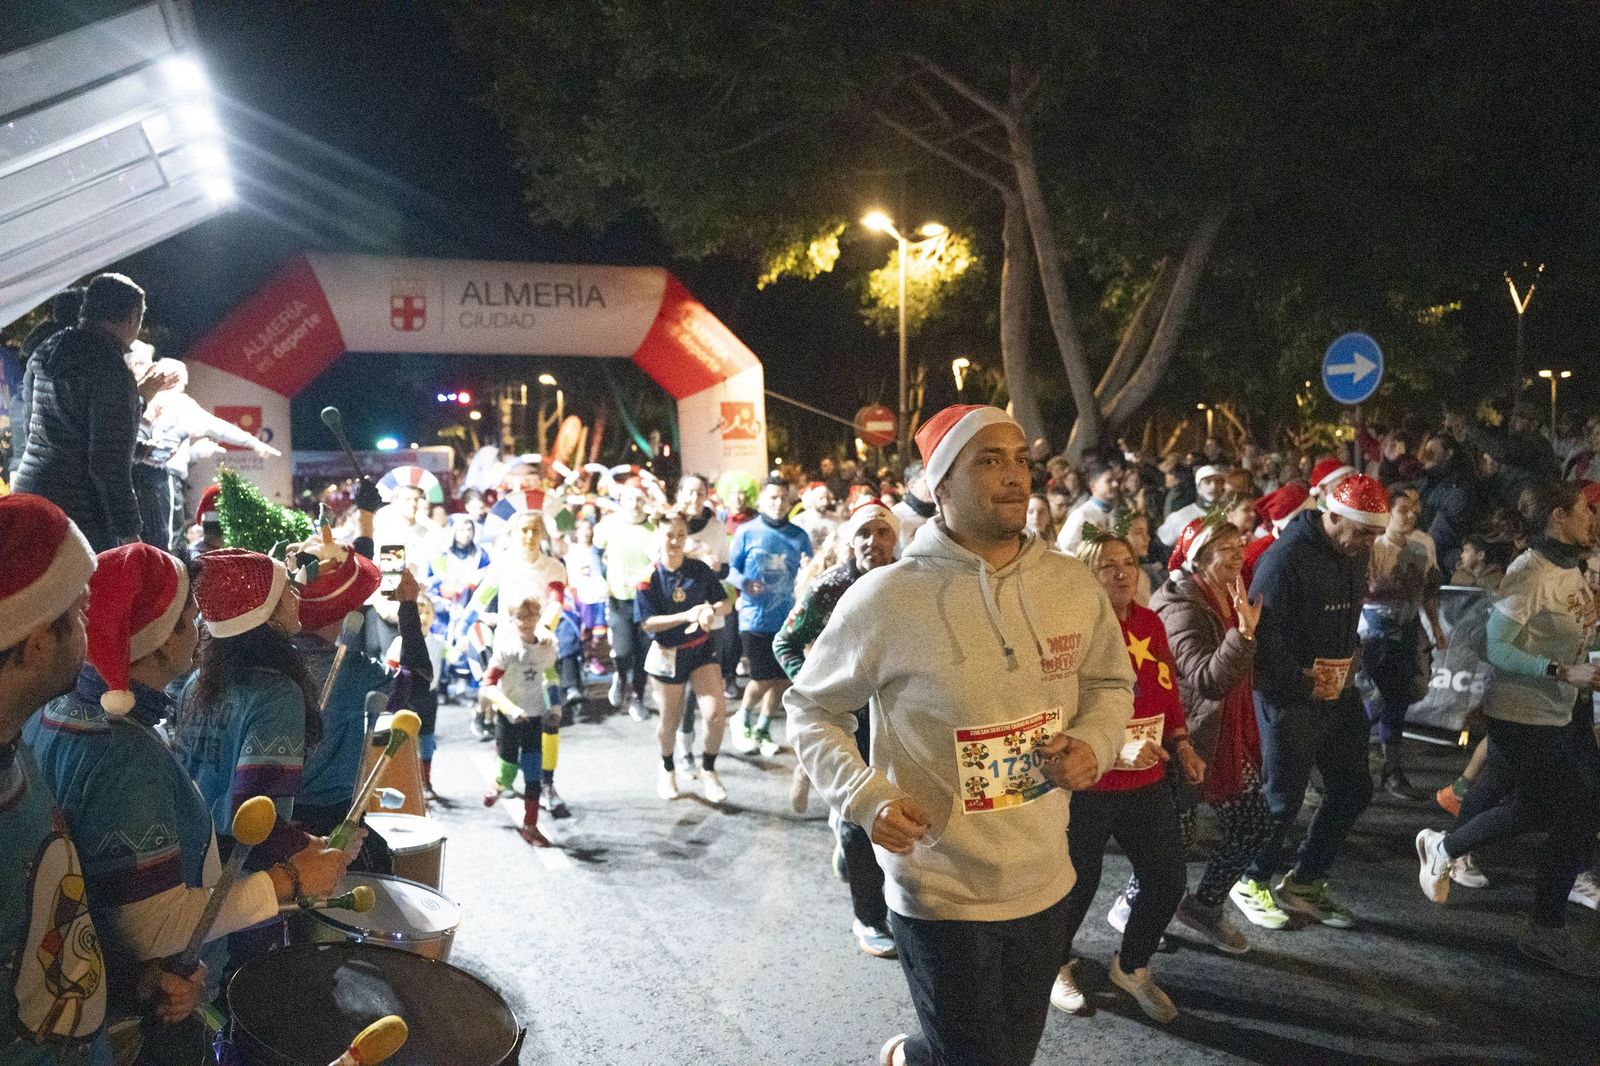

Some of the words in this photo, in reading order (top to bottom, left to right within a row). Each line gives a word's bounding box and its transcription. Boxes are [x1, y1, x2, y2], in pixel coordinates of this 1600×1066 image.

[461, 277, 606, 309] ALMERÍA
[459, 311, 536, 330] CIUDAD
[988, 749, 1042, 778] 1730
